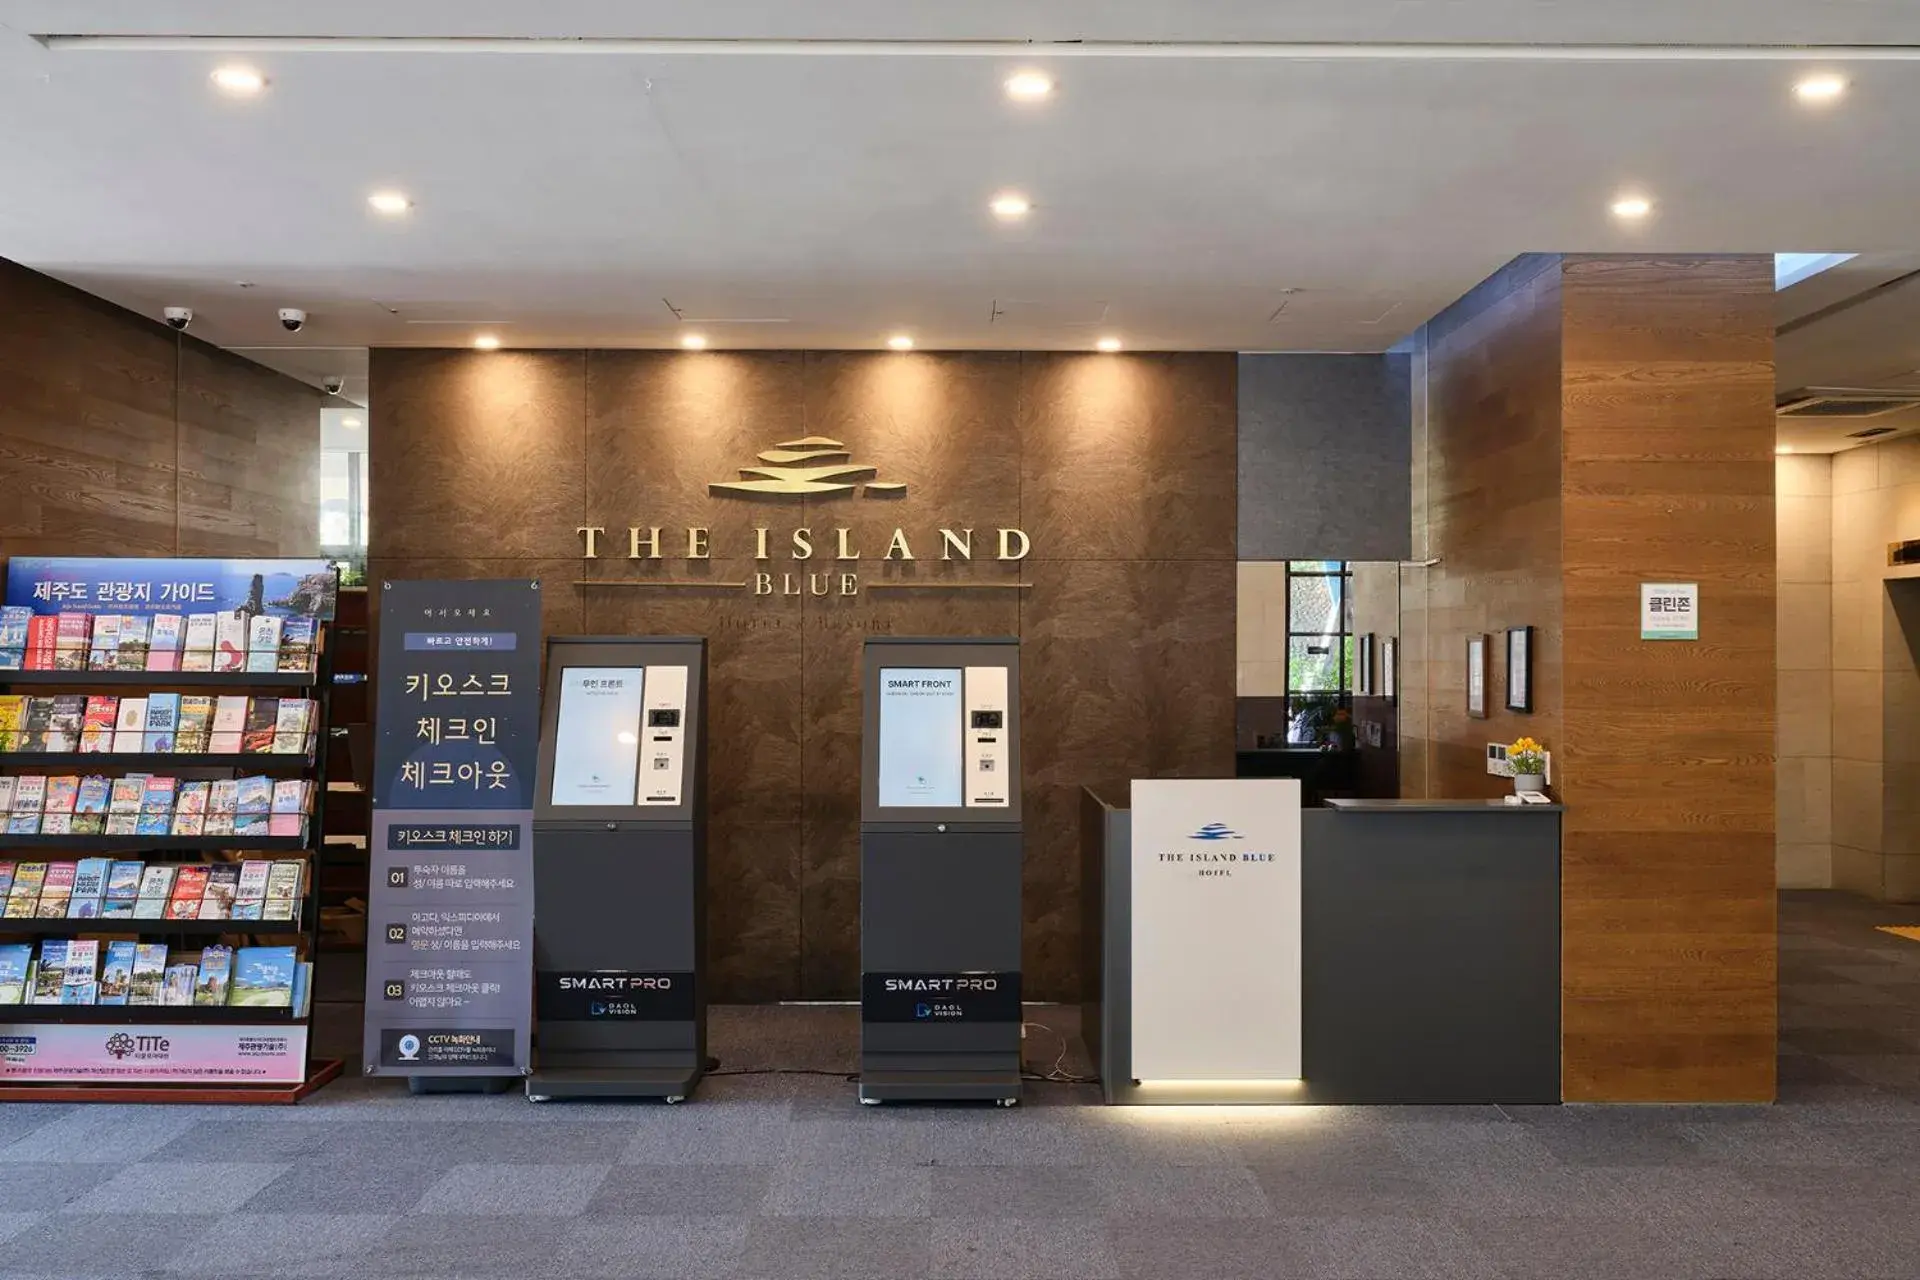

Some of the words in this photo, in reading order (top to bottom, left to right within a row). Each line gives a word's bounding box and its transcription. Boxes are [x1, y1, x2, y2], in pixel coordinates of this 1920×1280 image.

[576, 527, 711, 560] THE
[754, 527, 1032, 561] ISLAND
[33, 581, 88, 601] 제주도
[96, 581, 150, 602] 관광지
[160, 581, 215, 602] 가이드
[754, 573, 859, 596] BLUE
[1649, 597, 1691, 612] 클린존
[427, 637, 451, 646] 빠르고
[455, 637, 493, 647] 안전하게!
[405, 673, 512, 701] 키오스크
[888, 680, 919, 688] SMART
[921, 680, 952, 688] FRONT
[417, 717, 496, 746] 체크인
[401, 761, 511, 790] 체크아웃
[397, 830, 447, 845] 키오스크
[449, 830, 486, 845] 체크인
[488, 830, 513, 845] 하기
[1158, 854, 1184, 862] THE
[1189, 854, 1236, 862] ISLAND
[1242, 854, 1276, 862] BLUE
[390, 871, 405, 884] 01
[389, 928, 404, 940] 02
[386, 984, 402, 997] 03
[428, 1035, 450, 1044] CCTV
